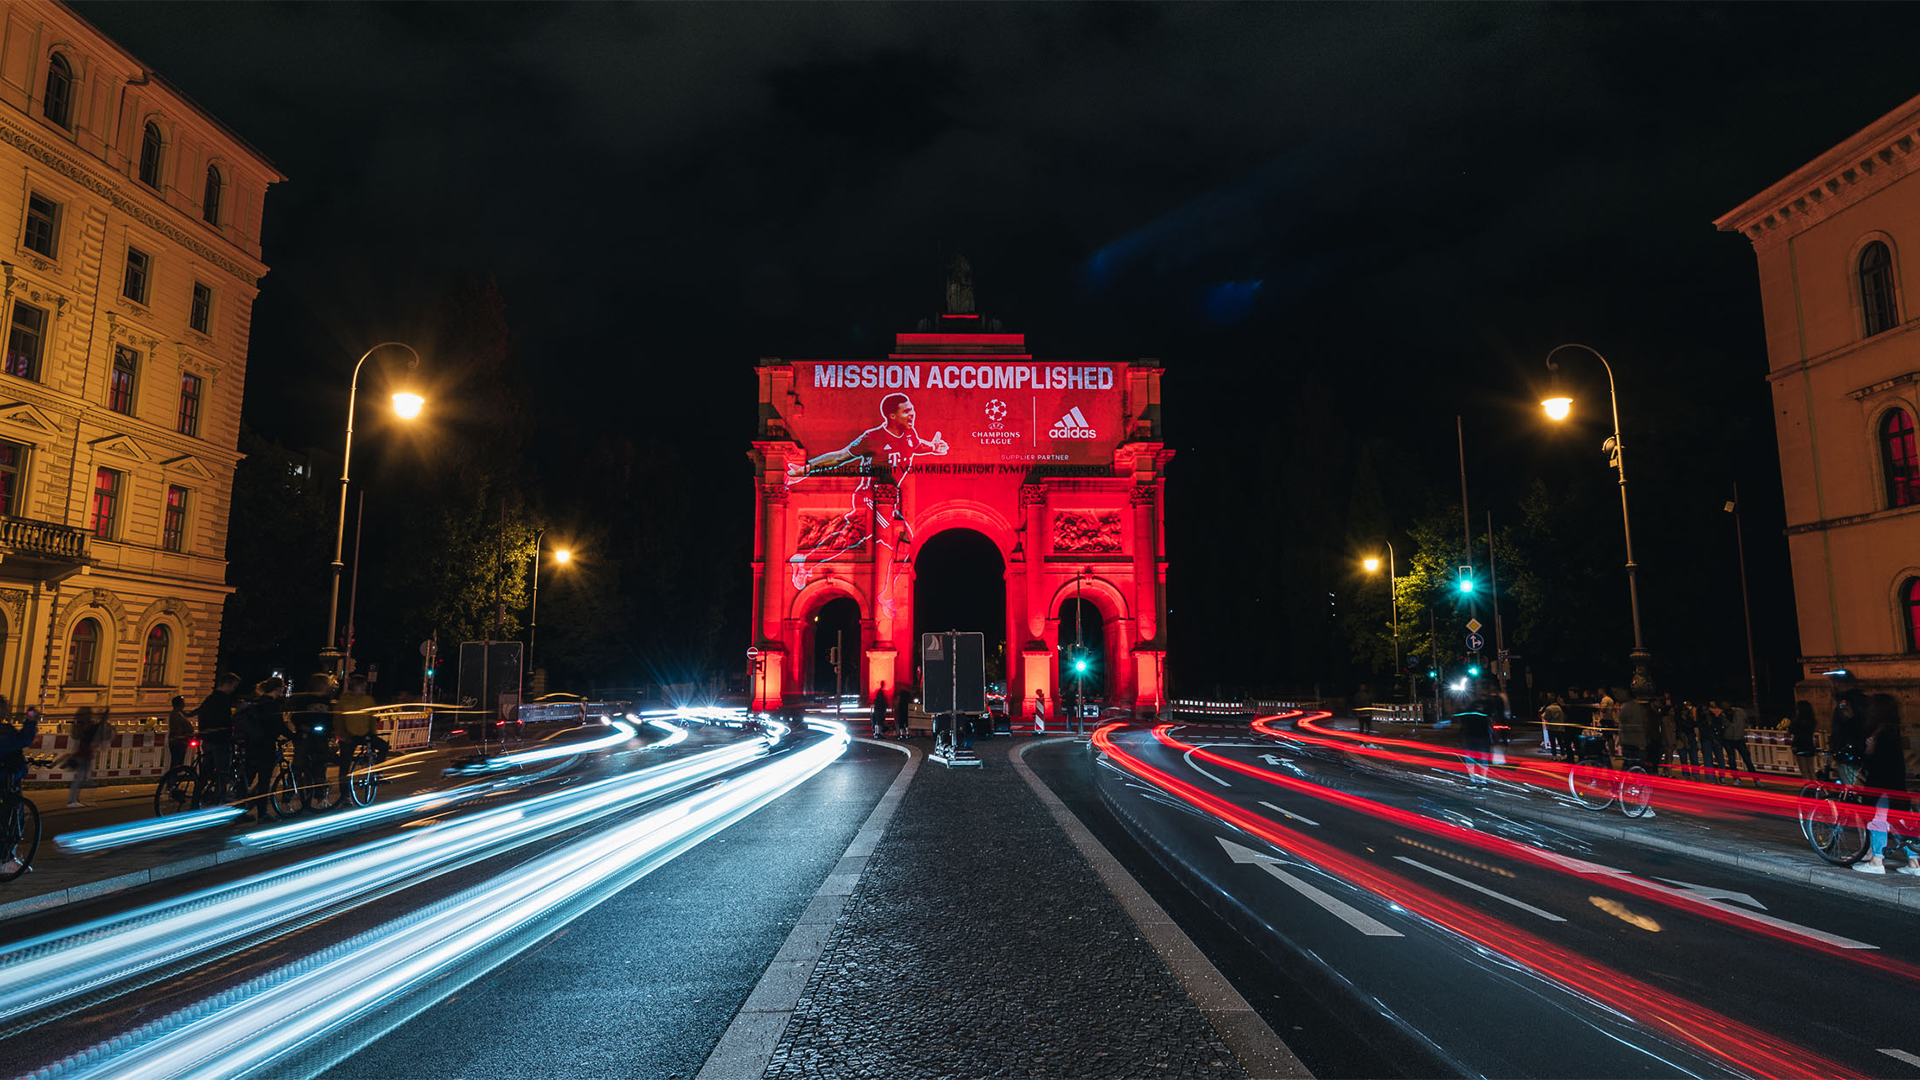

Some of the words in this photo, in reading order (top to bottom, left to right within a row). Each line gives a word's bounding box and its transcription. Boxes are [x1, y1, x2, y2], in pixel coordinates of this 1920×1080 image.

[814, 364, 920, 389] MISSION
[926, 365, 1114, 390] ACCOMPLISHED
[1048, 427, 1097, 439] adidas
[900, 464, 924, 474] VOM
